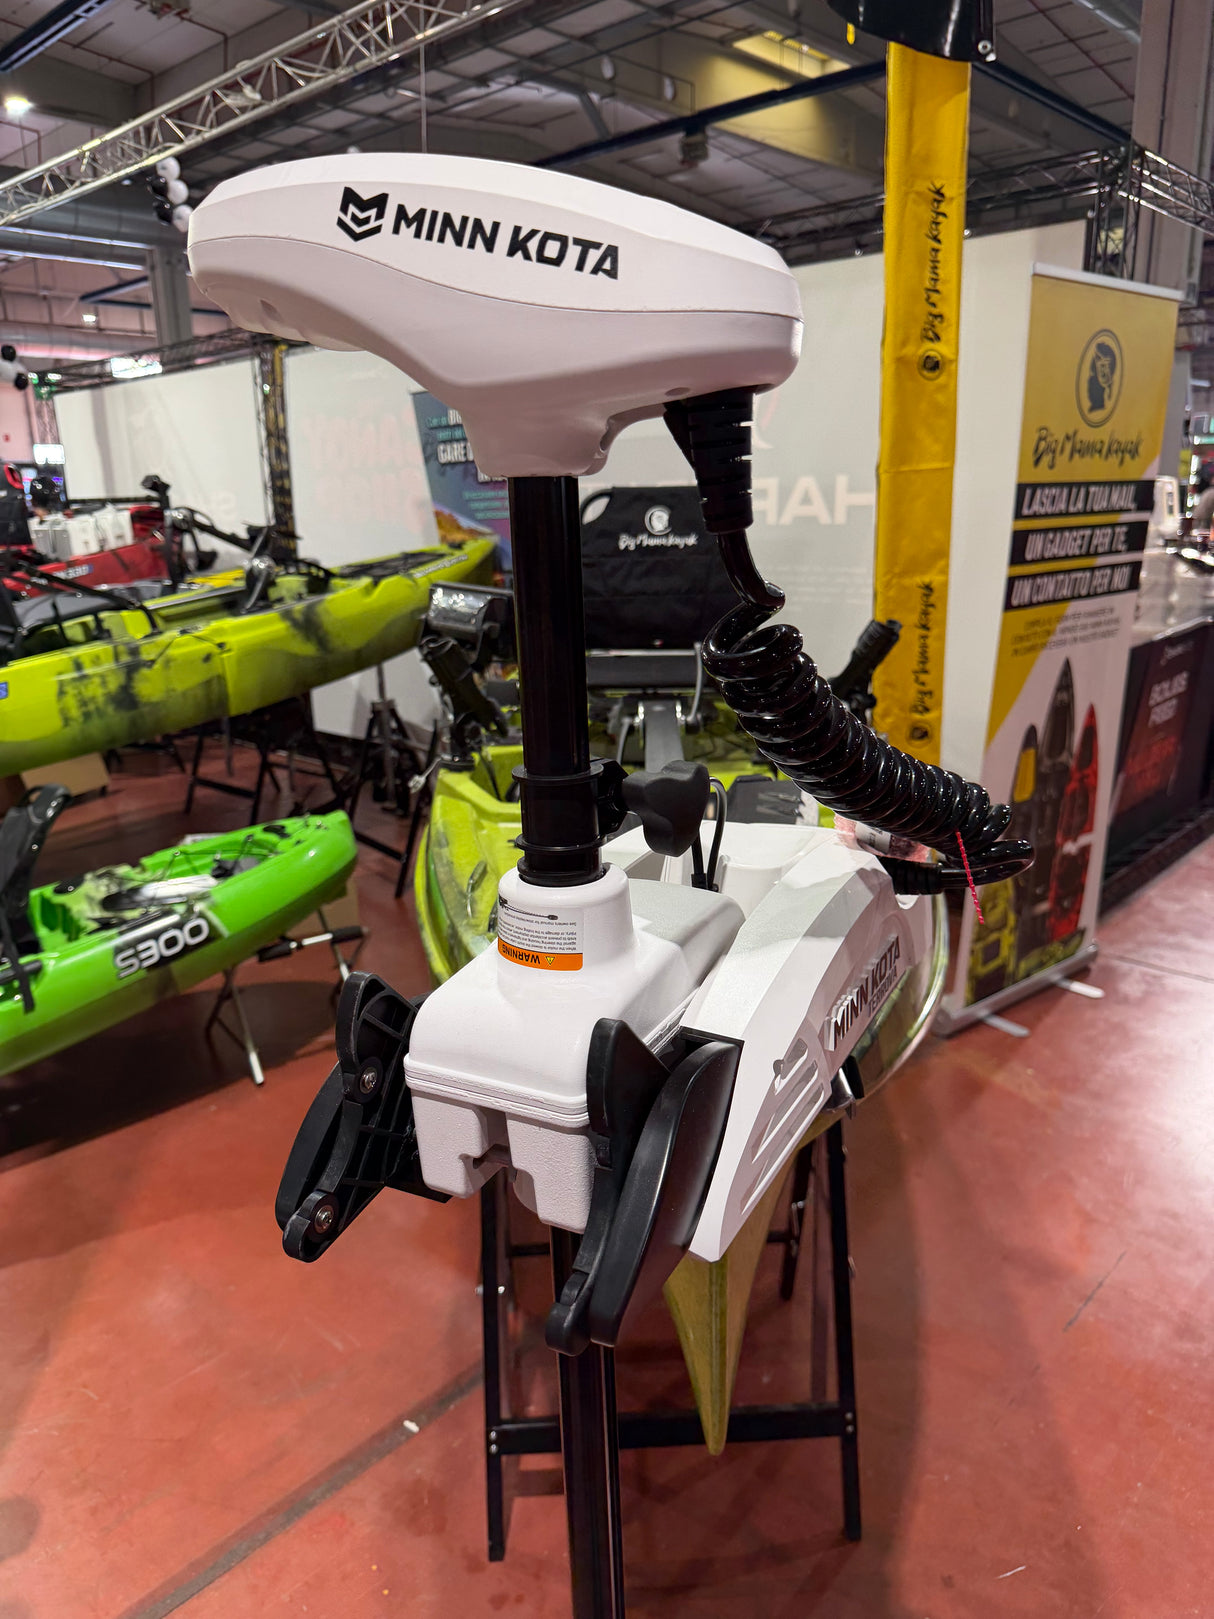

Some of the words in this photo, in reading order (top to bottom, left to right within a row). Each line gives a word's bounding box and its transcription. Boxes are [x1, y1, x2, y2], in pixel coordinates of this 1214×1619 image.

[392, 203, 501, 254] MINN
[506, 225, 619, 280] KOTA
[923, 248, 942, 308] Mama
[920, 313, 943, 343] Big
[1032, 427, 1058, 470] Big
[1059, 429, 1105, 462] Mama
[1021, 486, 1069, 516] LASCIA
[1068, 486, 1087, 513] LA
[1086, 485, 1110, 512] TUA
[1109, 484, 1137, 512] MAIL,
[1025, 532, 1044, 561] UN
[1043, 529, 1092, 559] GADGET
[1089, 527, 1113, 555] PER
[1010, 577, 1032, 607] UN
[1031, 570, 1091, 604] CONTATTO
[1089, 567, 1112, 596] PER
[1109, 564, 1132, 593] NOI
[115, 917, 210, 978] S300
[502, 944, 540, 964] WARNING
[826, 975, 869, 1051] MINN
[869, 935, 901, 997] KOTA
